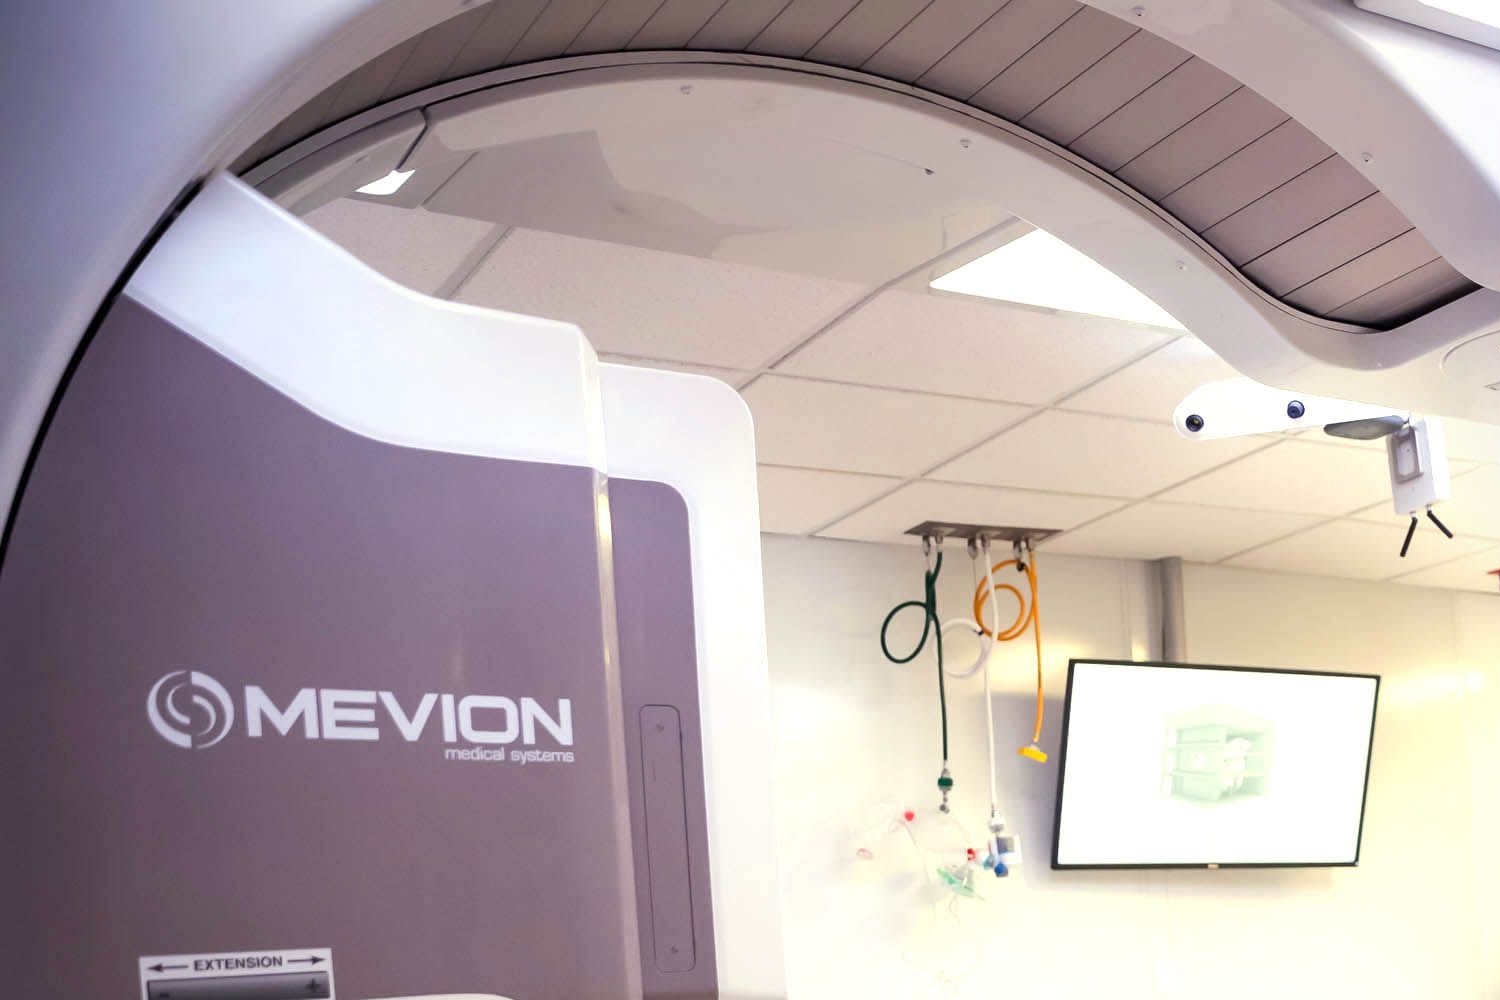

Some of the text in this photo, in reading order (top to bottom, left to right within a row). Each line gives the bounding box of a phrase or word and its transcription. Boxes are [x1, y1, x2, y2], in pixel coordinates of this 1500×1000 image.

[244, 686, 573, 745] MEVION
[444, 747, 575, 765] medical systems
[193, 955, 284, 972] EXTENSION
